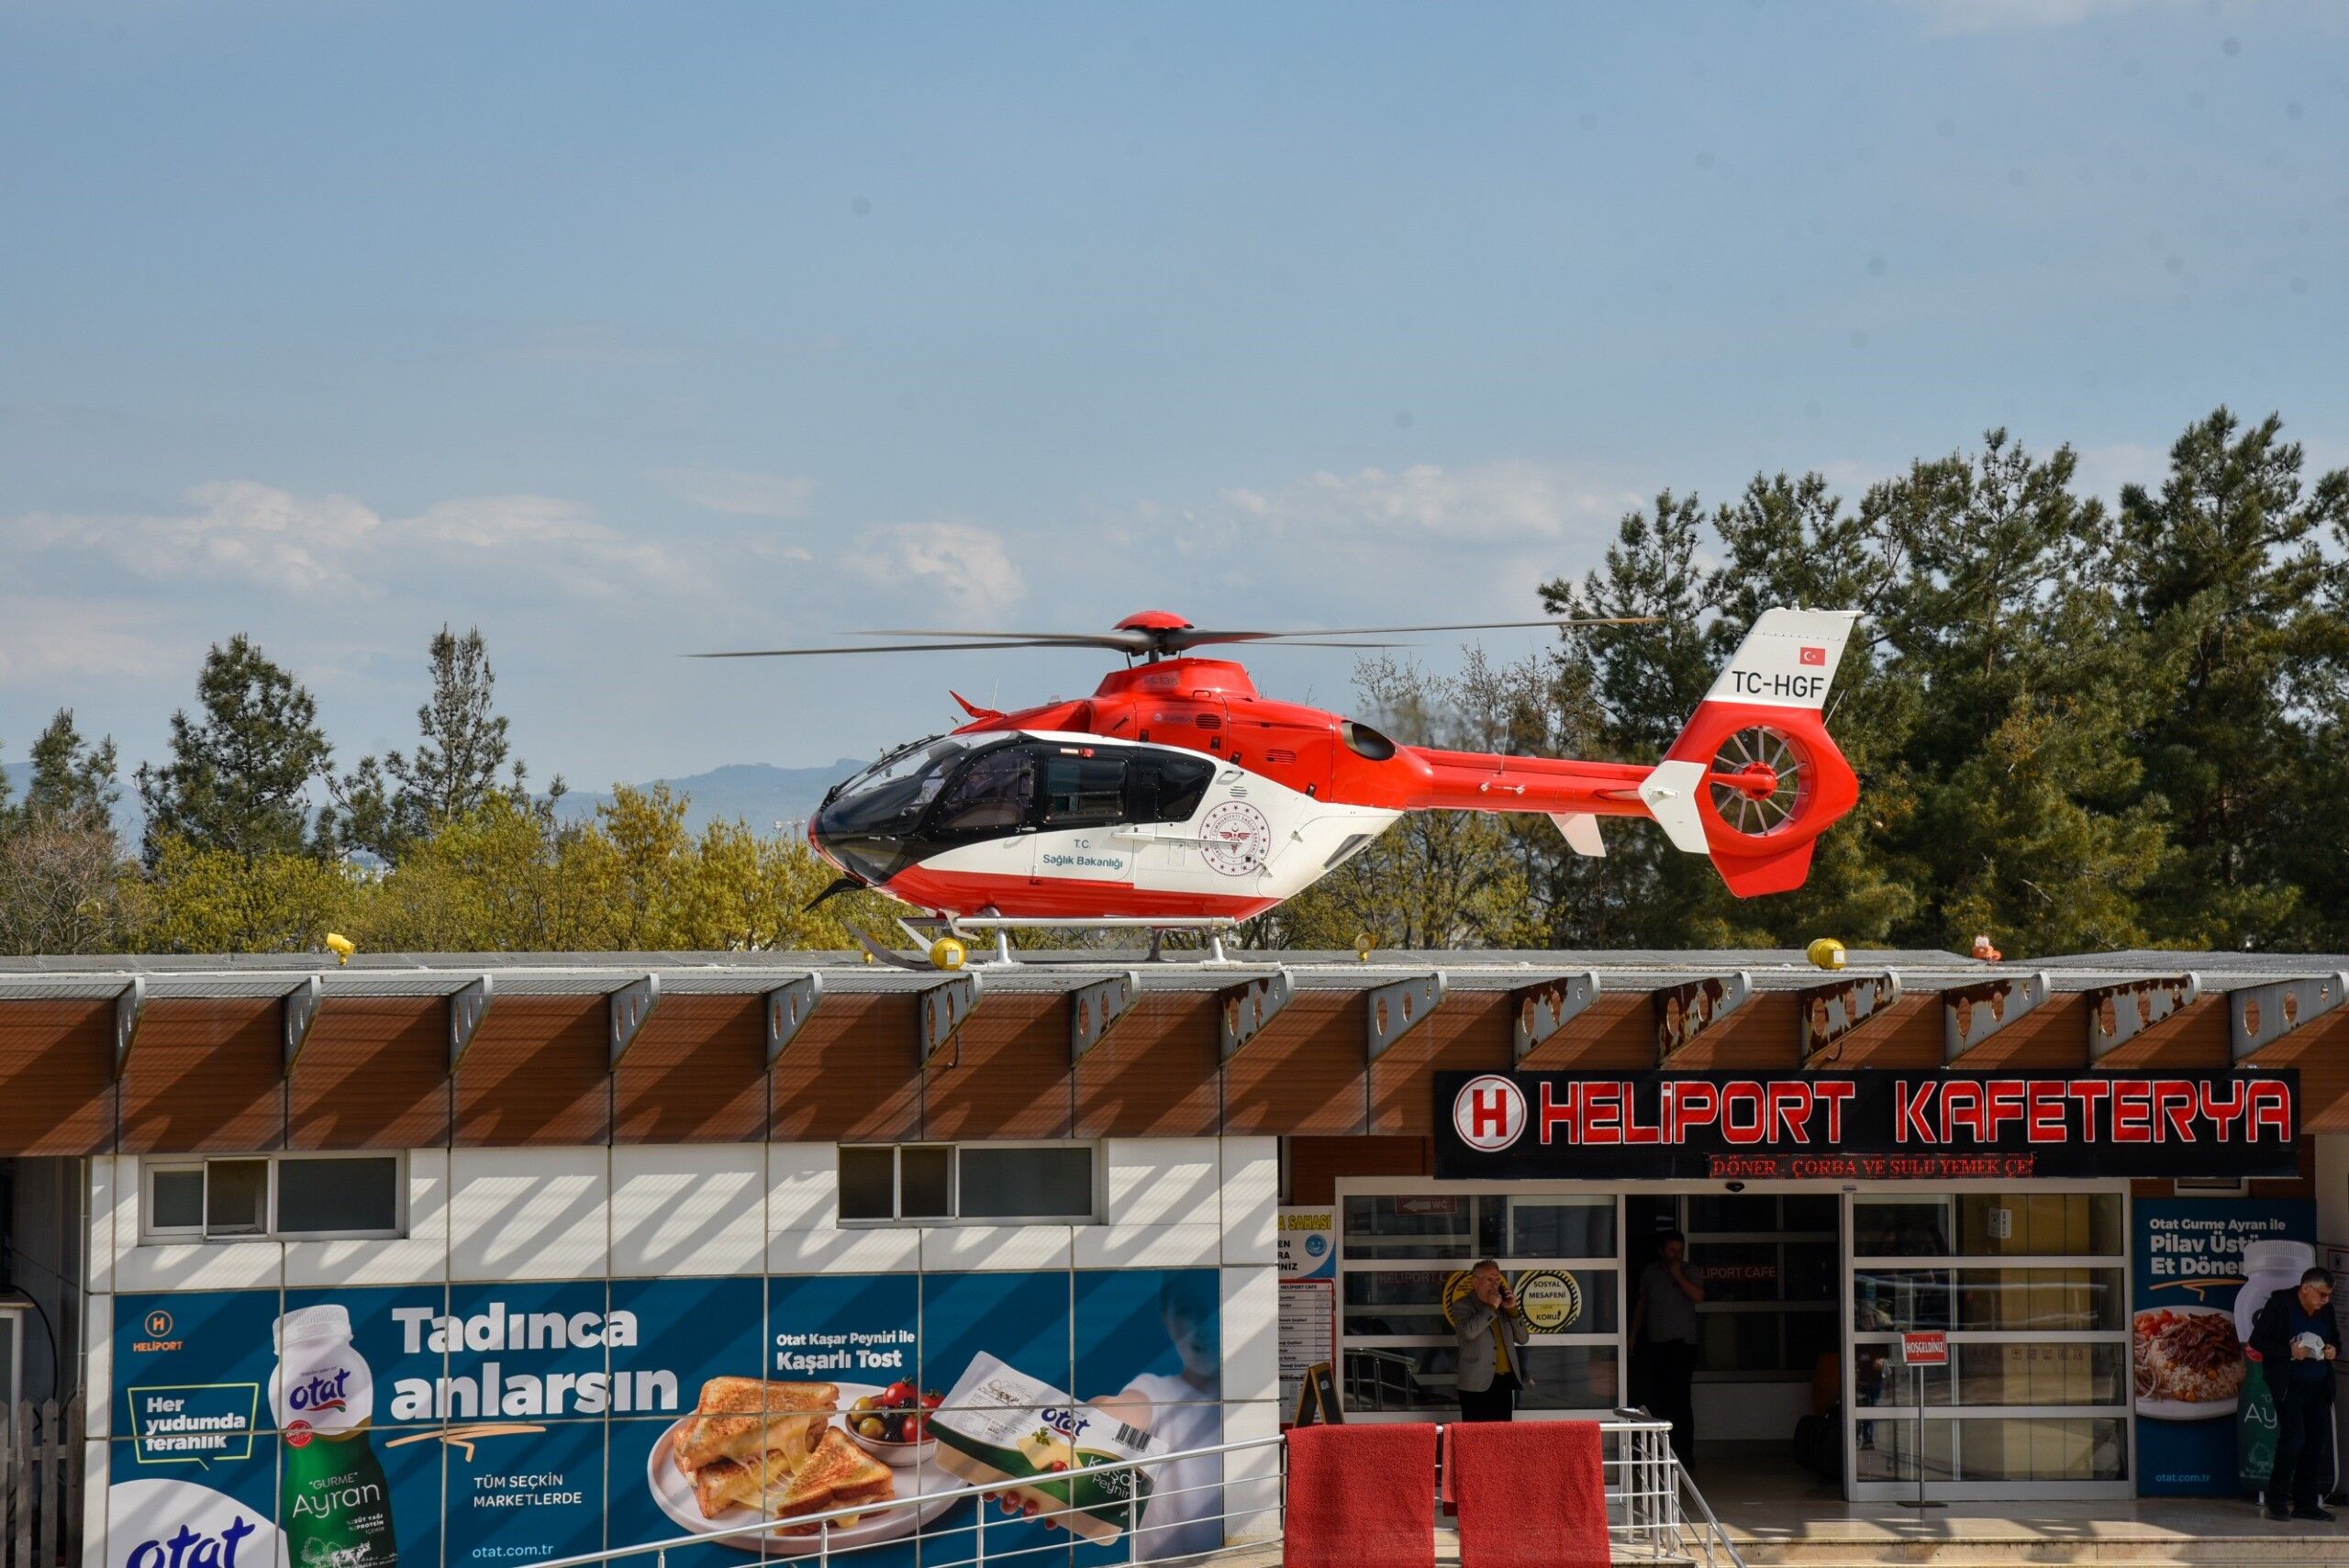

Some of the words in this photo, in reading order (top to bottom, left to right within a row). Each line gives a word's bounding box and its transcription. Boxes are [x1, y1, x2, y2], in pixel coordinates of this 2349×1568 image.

[1731, 671, 1824, 698] TC-HGF
[1074, 840, 1092, 849] T.C.
[1042, 854, 1074, 866] Sağlık
[1076, 856, 1123, 870] Bakanlığı
[1472, 1088, 1508, 1138] H
[1895, 1080, 2291, 1143] KAFETERYA
[1713, 1155, 1776, 1175] DÖNER
[1791, 1159, 1857, 1178] ÇORBA
[1862, 1160, 1885, 1174] VE
[1940, 1160, 2000, 1174] YEMEK
[1431, 1198, 1447, 1209] WC
[1288, 1214, 1331, 1230] SAHASI
[2150, 1218, 2178, 1229] Otat
[2182, 1219, 2225, 1229] Gurme
[2228, 1219, 2267, 1232] Ayran
[2270, 1218, 2286, 1230] ile
[2151, 1232, 2205, 1252] Pilav
[2210, 1230, 2260, 1253] Üst
[1745, 1266, 1776, 1277] CAFE
[2152, 1257, 2176, 1274] Et
[1536, 1310, 1561, 1320] KORU!
[152, 1318, 164, 1330] H
[392, 1302, 638, 1353] Tadınca
[776, 1334, 806, 1346] Otat
[809, 1333, 848, 1348] Kaşar
[850, 1330, 896, 1346] Peyniri
[898, 1329, 915, 1342] ile
[1906, 1339, 1944, 1356] HOŞGELDİNİZ
[777, 1350, 852, 1375] Kaşarlı
[856, 1349, 902, 1368] Tost
[289, 1367, 351, 1410] otat
[390, 1362, 678, 1420] anlarsın
[147, 1396, 184, 1412] Her
[145, 1413, 246, 1435] yudumda
[1041, 1407, 1091, 1437] otat
[473, 1474, 506, 1489] TÜM
[509, 1472, 563, 1490] SEÇKİN
[2155, 1473, 2211, 1483] otat.com.tr
[292, 1484, 381, 1519] Ayran
[473, 1492, 583, 1507] MARKETLERDE
[126, 1516, 255, 1568] otat
[472, 1544, 554, 1558] otat.com.tr
